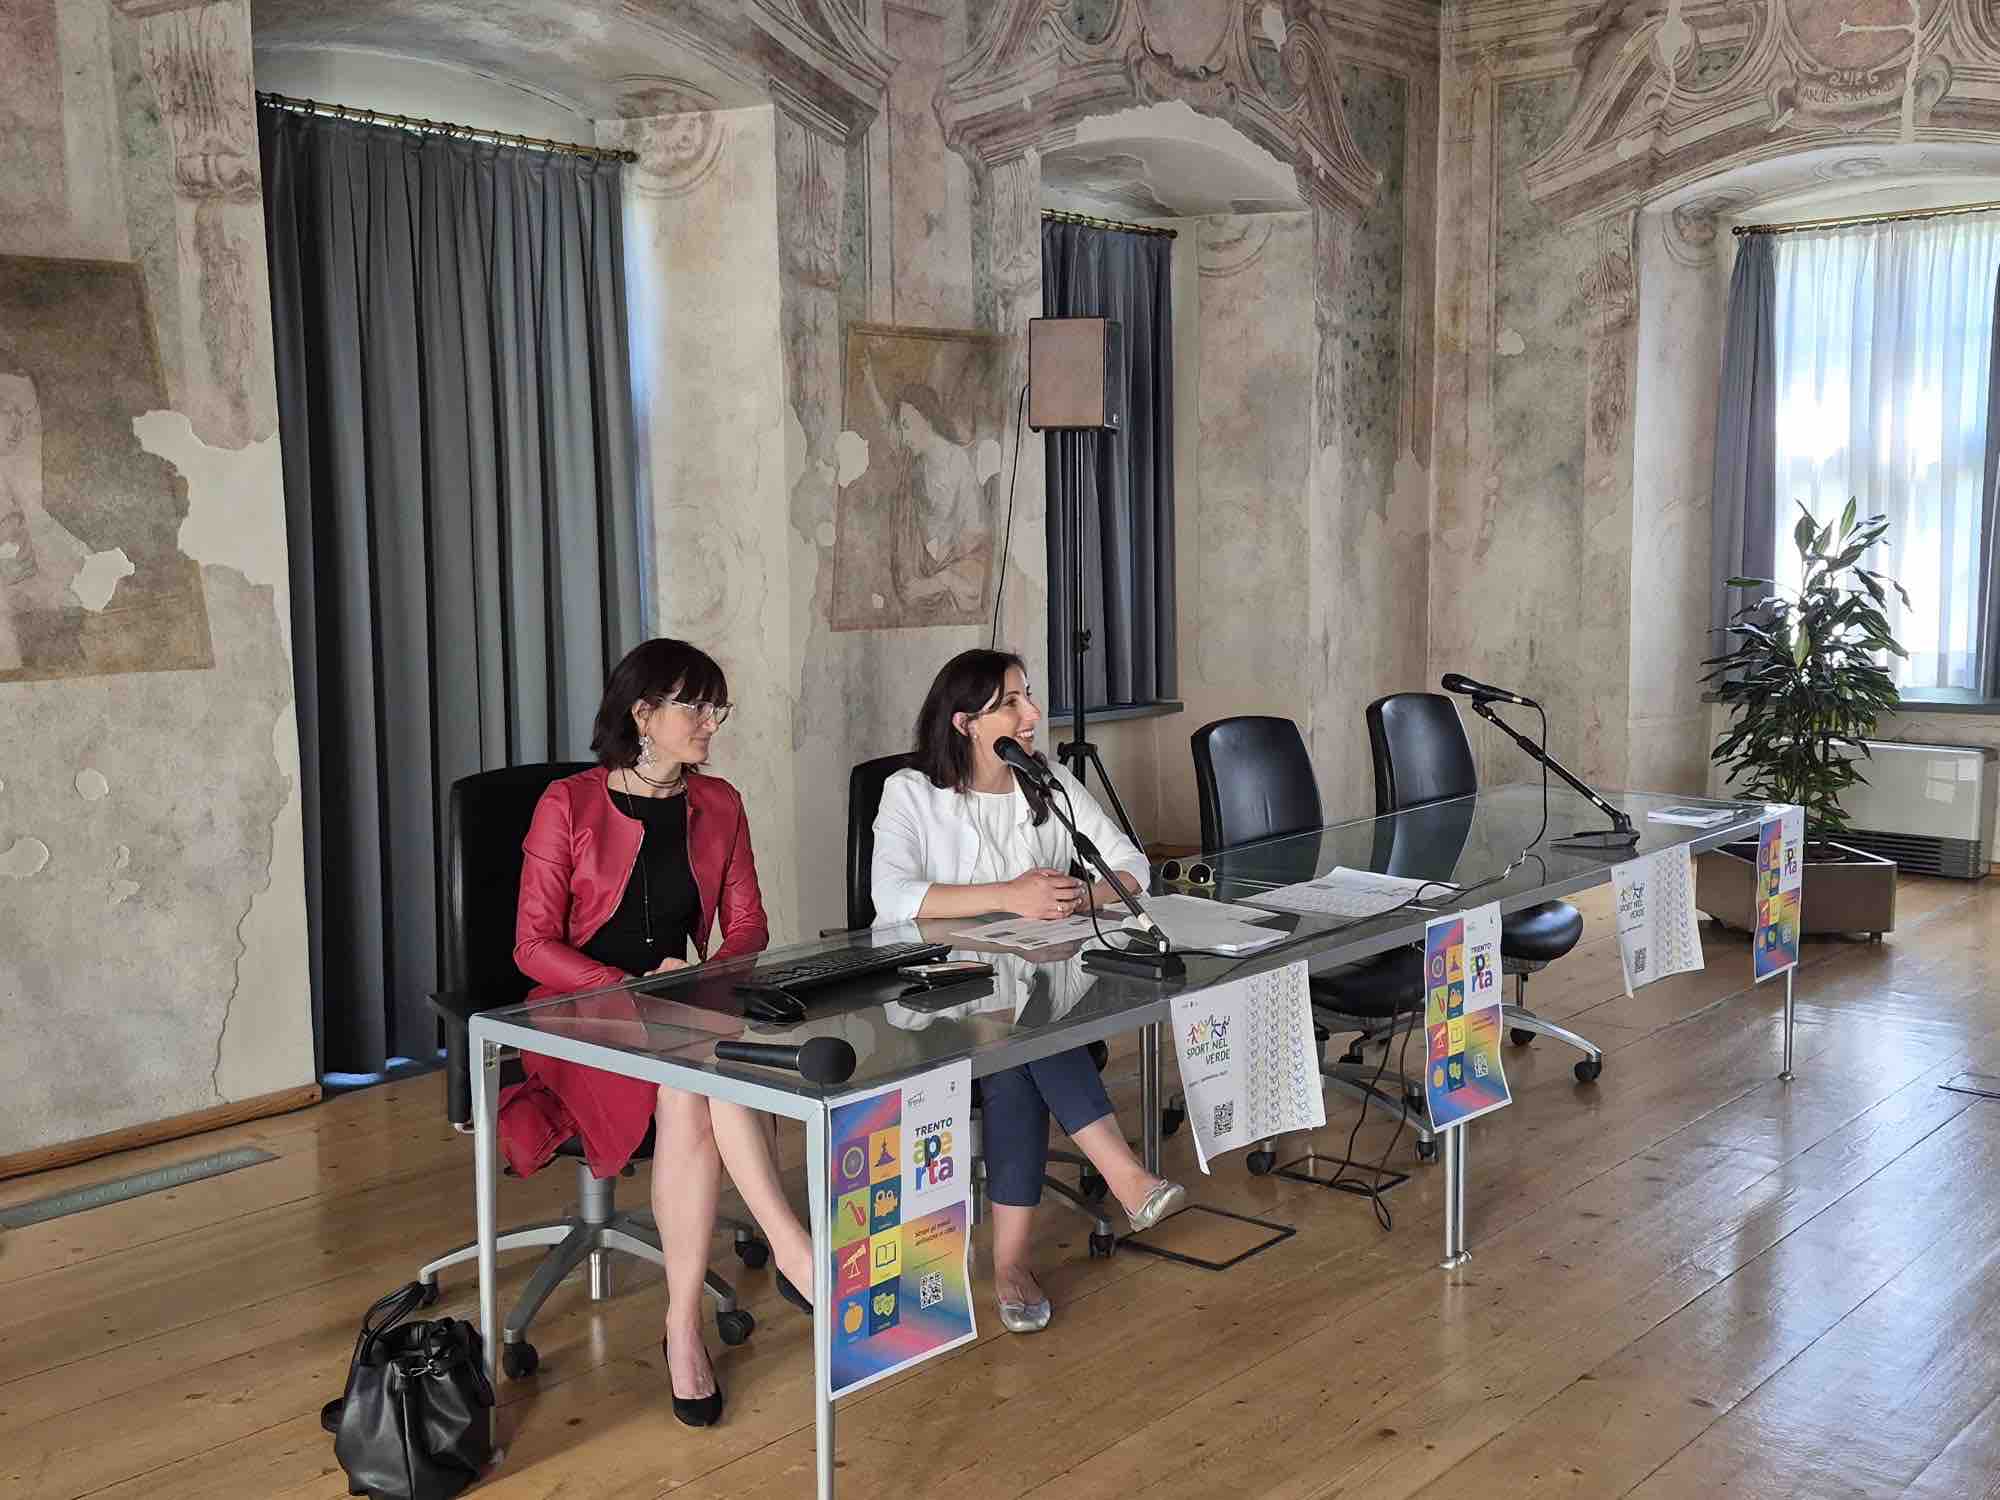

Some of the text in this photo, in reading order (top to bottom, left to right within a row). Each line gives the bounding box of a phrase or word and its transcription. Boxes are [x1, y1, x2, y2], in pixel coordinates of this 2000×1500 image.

[1186, 1038, 1228, 1059] SPORT NEL
[1206, 1049, 1230, 1064] VERDE
[915, 1117, 953, 1137] TRENTO
[913, 1131, 953, 1167] ape
[916, 1156, 954, 1190] rta
